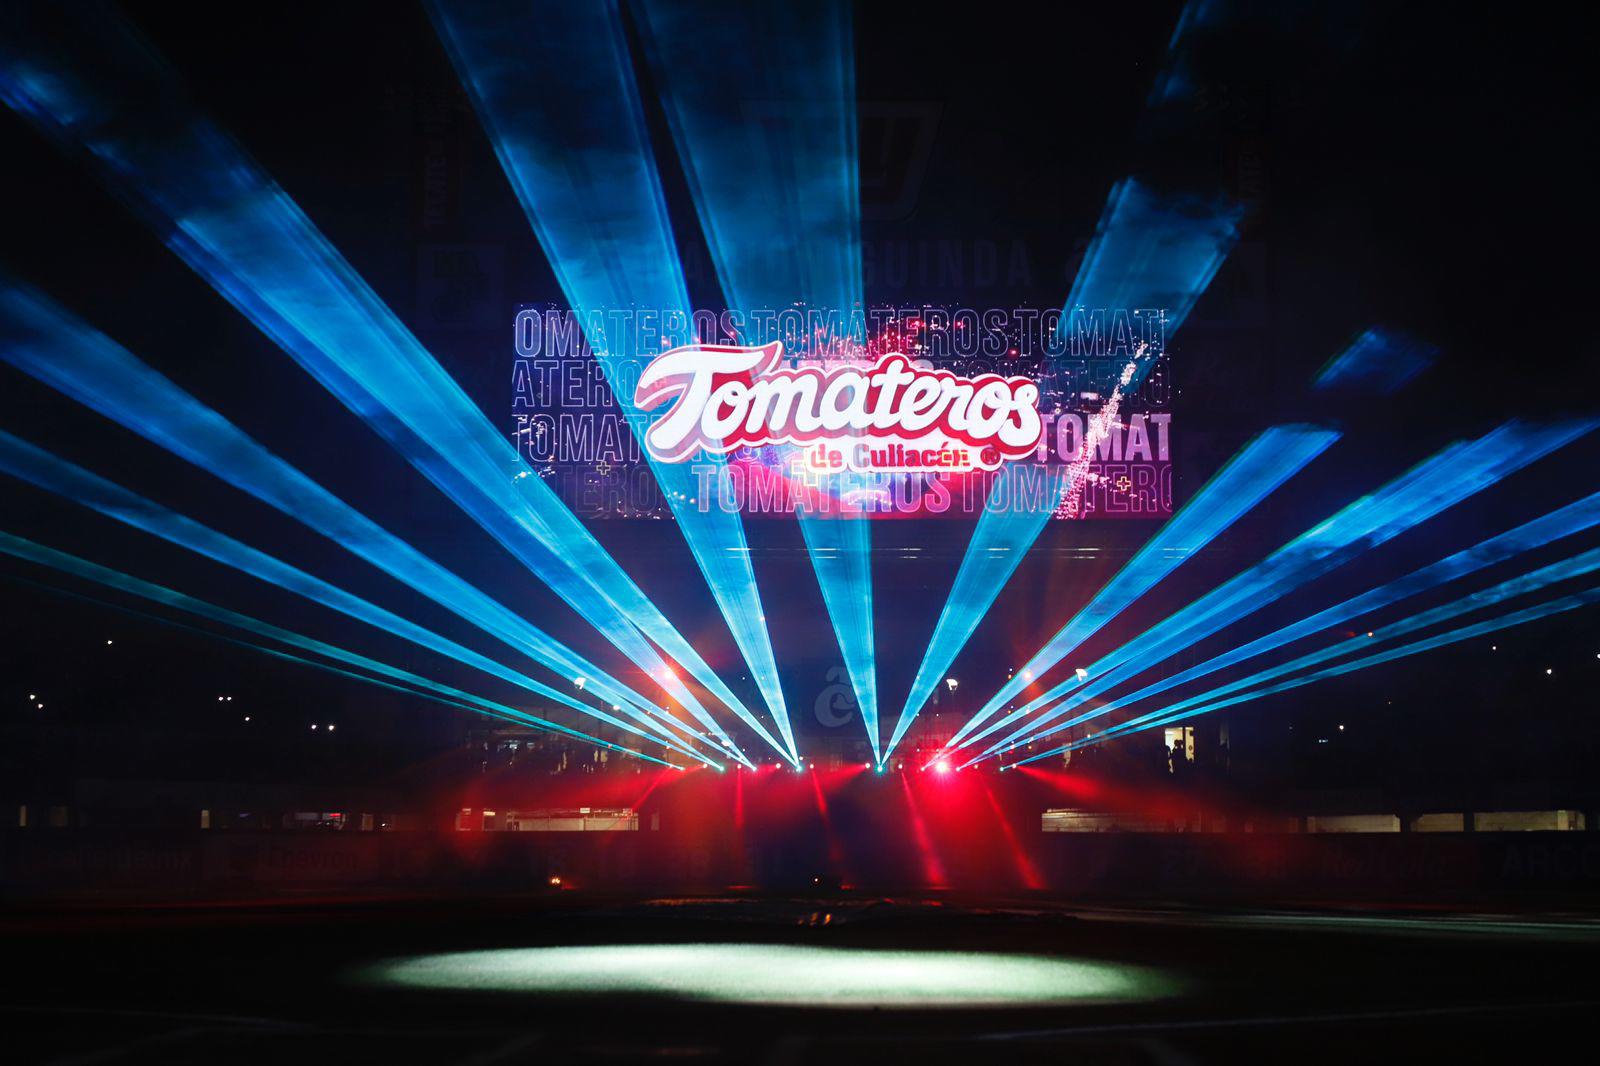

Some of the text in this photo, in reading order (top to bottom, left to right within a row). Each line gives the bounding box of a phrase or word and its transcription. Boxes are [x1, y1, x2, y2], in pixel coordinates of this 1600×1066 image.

[634, 343, 1041, 458] Tomateros
[810, 441, 971, 468] de Culiacán
